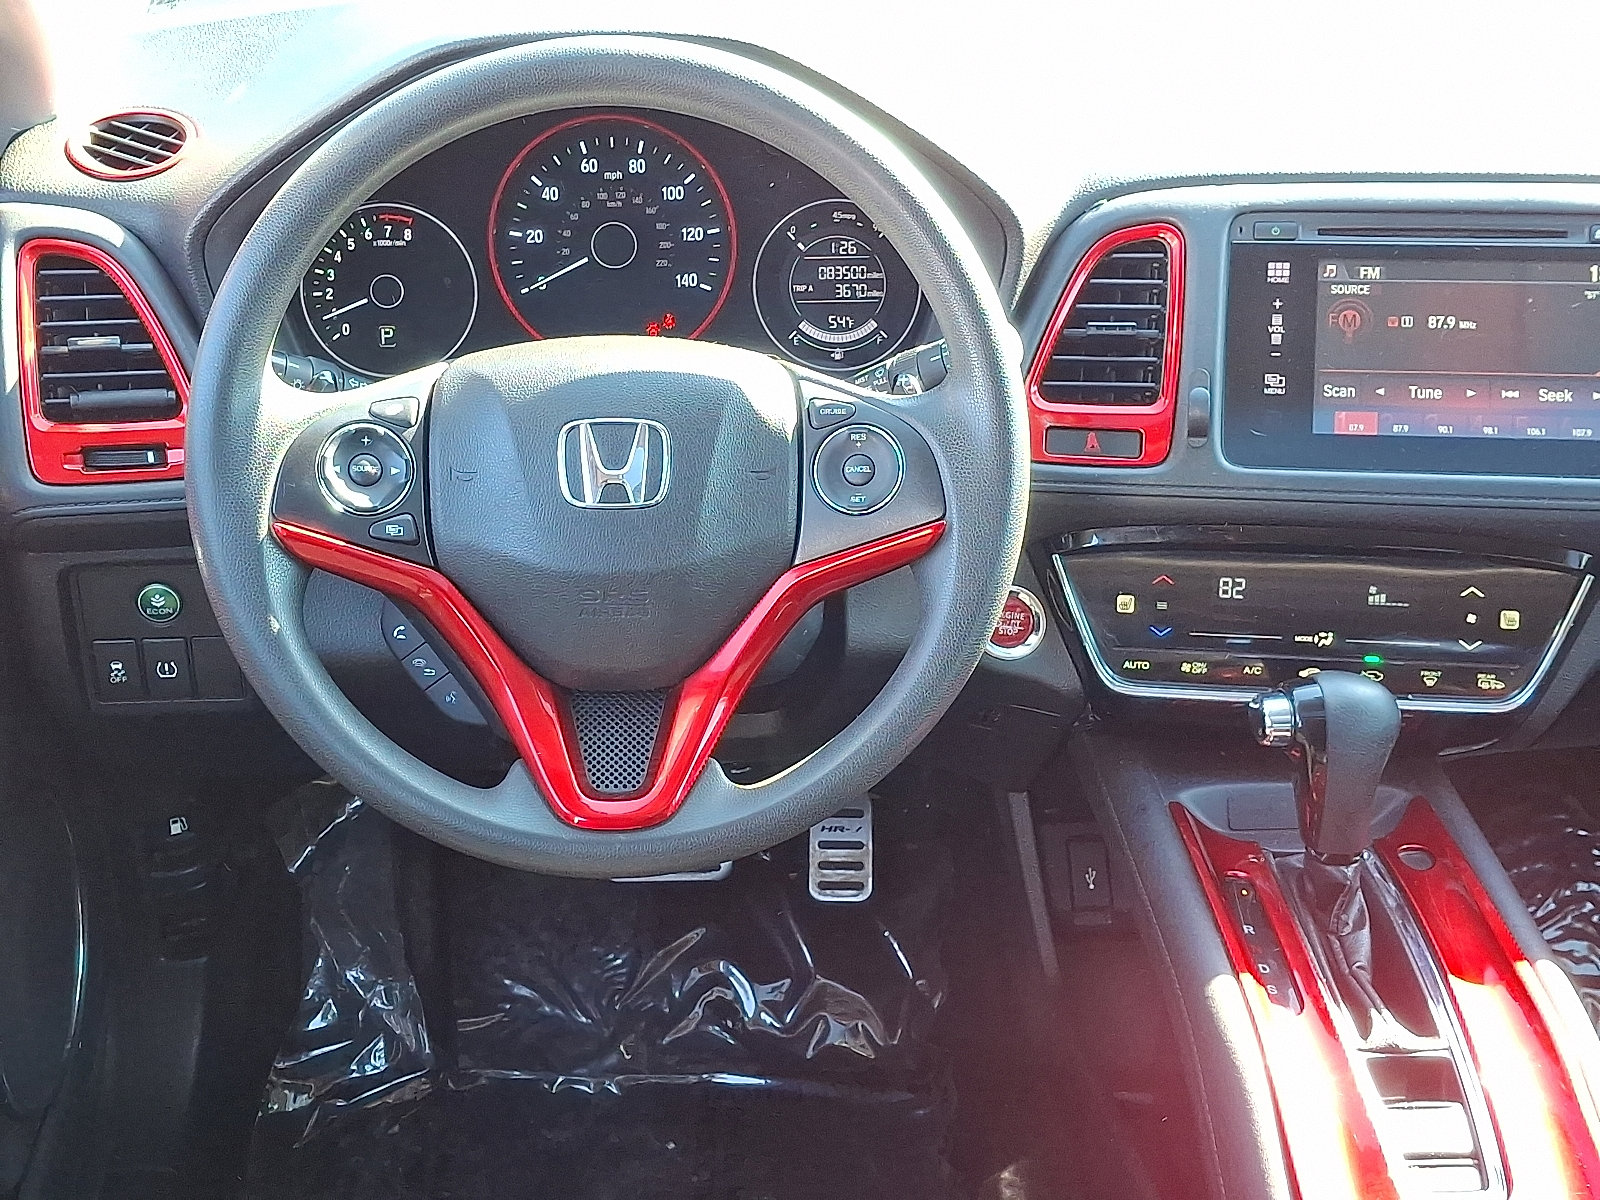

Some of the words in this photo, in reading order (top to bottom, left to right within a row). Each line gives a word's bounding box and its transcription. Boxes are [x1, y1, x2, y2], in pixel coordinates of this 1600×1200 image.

[580, 158, 598, 173] 60
[628, 158, 646, 173] 80
[603, 170, 623, 181] mph
[541, 186, 559, 201] 40
[615, 191, 626, 199] 120
[661, 185, 685, 200] 100
[364, 228, 373, 240] 6
[384, 225, 392, 238] 7
[403, 228, 412, 241] 8
[526, 229, 544, 244] 20
[681, 227, 704, 241] 120
[347, 237, 356, 250] 5
[831, 240, 857, 254] 1:26
[333, 250, 342, 263] 4
[326, 268, 335, 281] 3
[818, 265, 867, 280] 083500
[1359, 266, 1381, 279] FM
[675, 273, 698, 288] 140
[325, 288, 334, 300] 2
[792, 284, 807, 292] TRIP
[807, 284, 814, 292] A
[1330, 284, 1371, 295] SOURCE
[1427, 315, 1456, 329] 87.9
[1458, 320, 1477, 329] MHz
[341, 323, 350, 336] 0
[1267, 325, 1286, 334] VOL
[380, 327, 395, 346] P
[793, 337, 800, 346] E
[876, 336, 883, 345] F
[1323, 384, 1356, 398] Scan
[1408, 385, 1443, 400] Tune
[1538, 388, 1574, 403] Seek
[845, 465, 872, 473] CANCEL
[1218, 577, 1246, 599] 82
[146, 607, 173, 615] ECON
[1122, 660, 1150, 669] AUTO
[1243, 666, 1263, 675] A/C
[110, 676, 127, 684] OFF
[1243, 924, 1256, 935] R
